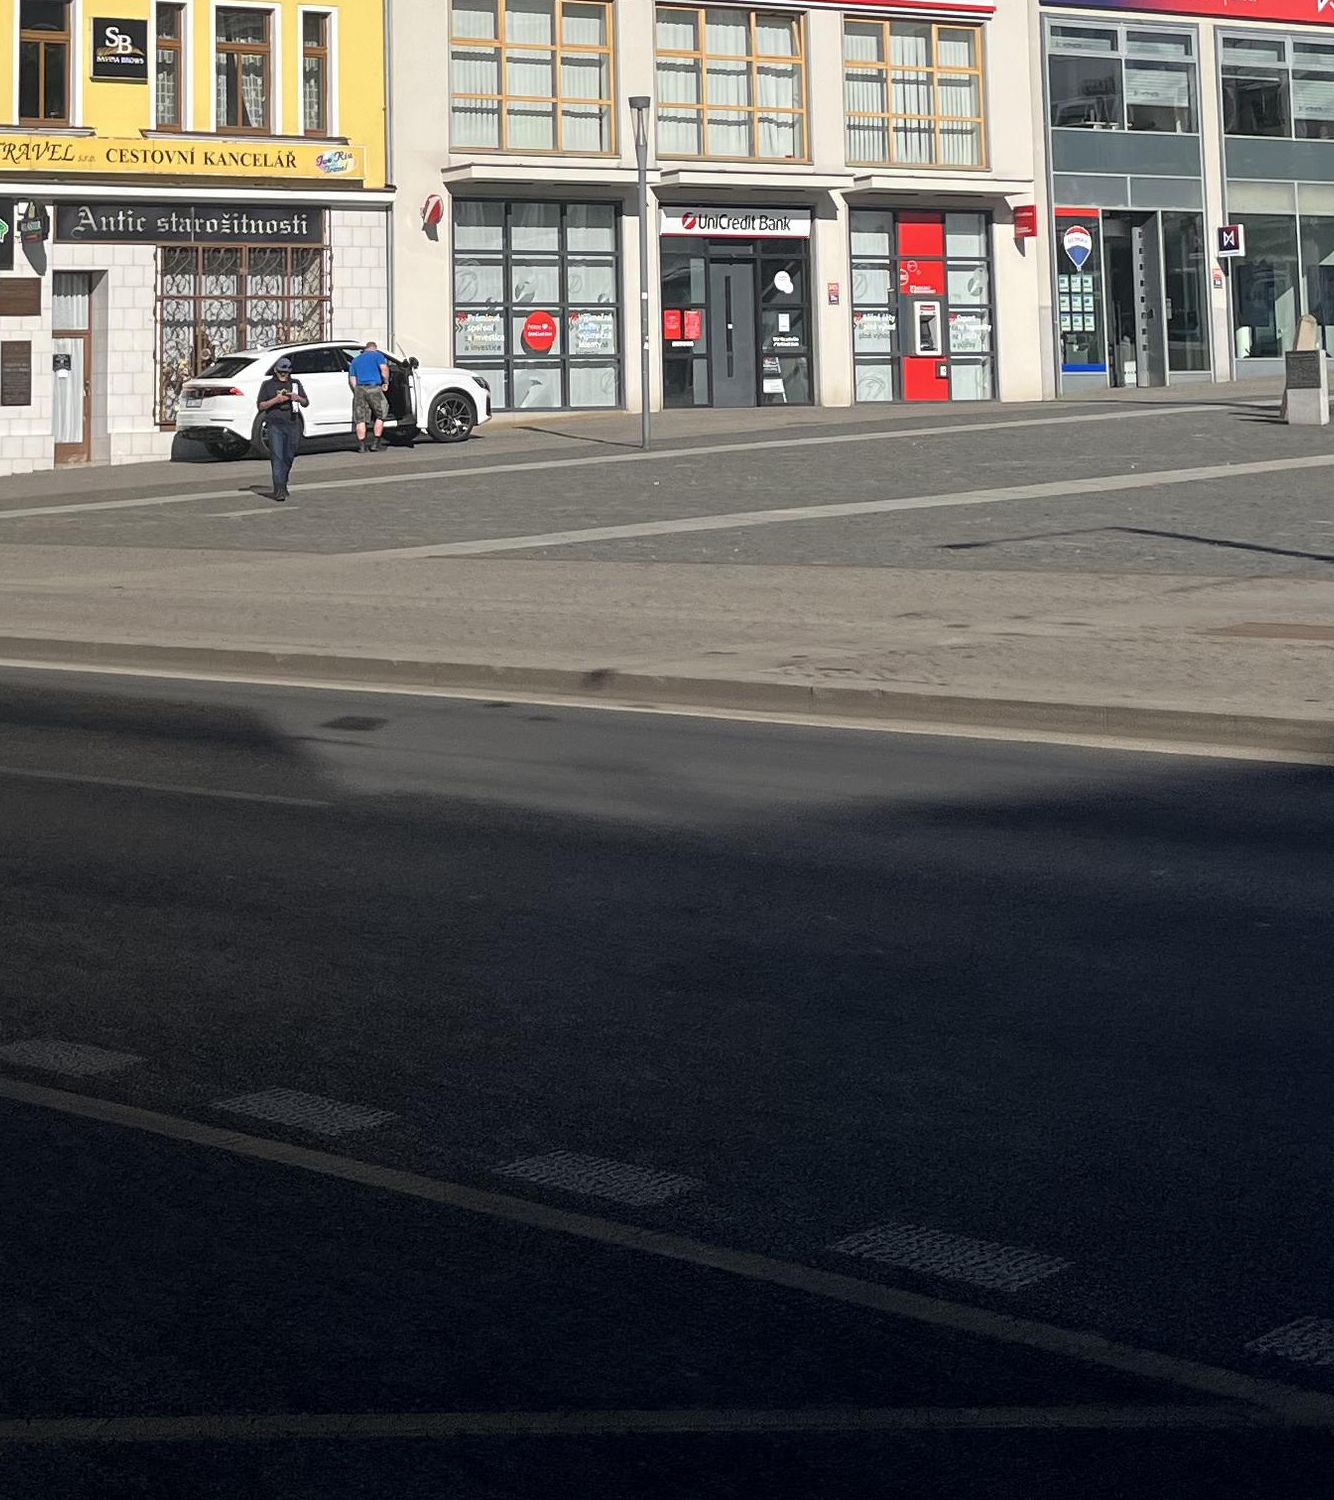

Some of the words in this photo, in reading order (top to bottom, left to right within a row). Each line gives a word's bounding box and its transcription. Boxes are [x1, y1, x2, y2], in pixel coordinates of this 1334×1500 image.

[106, 148, 195, 165] CESTOVNÍ
[203, 150, 297, 168] KANCELÁŘ
[70, 206, 147, 239] Antic
[156, 211, 308, 236] starožitnosti
[698, 213, 756, 230] UniCredit
[759, 214, 790, 231] Bank
